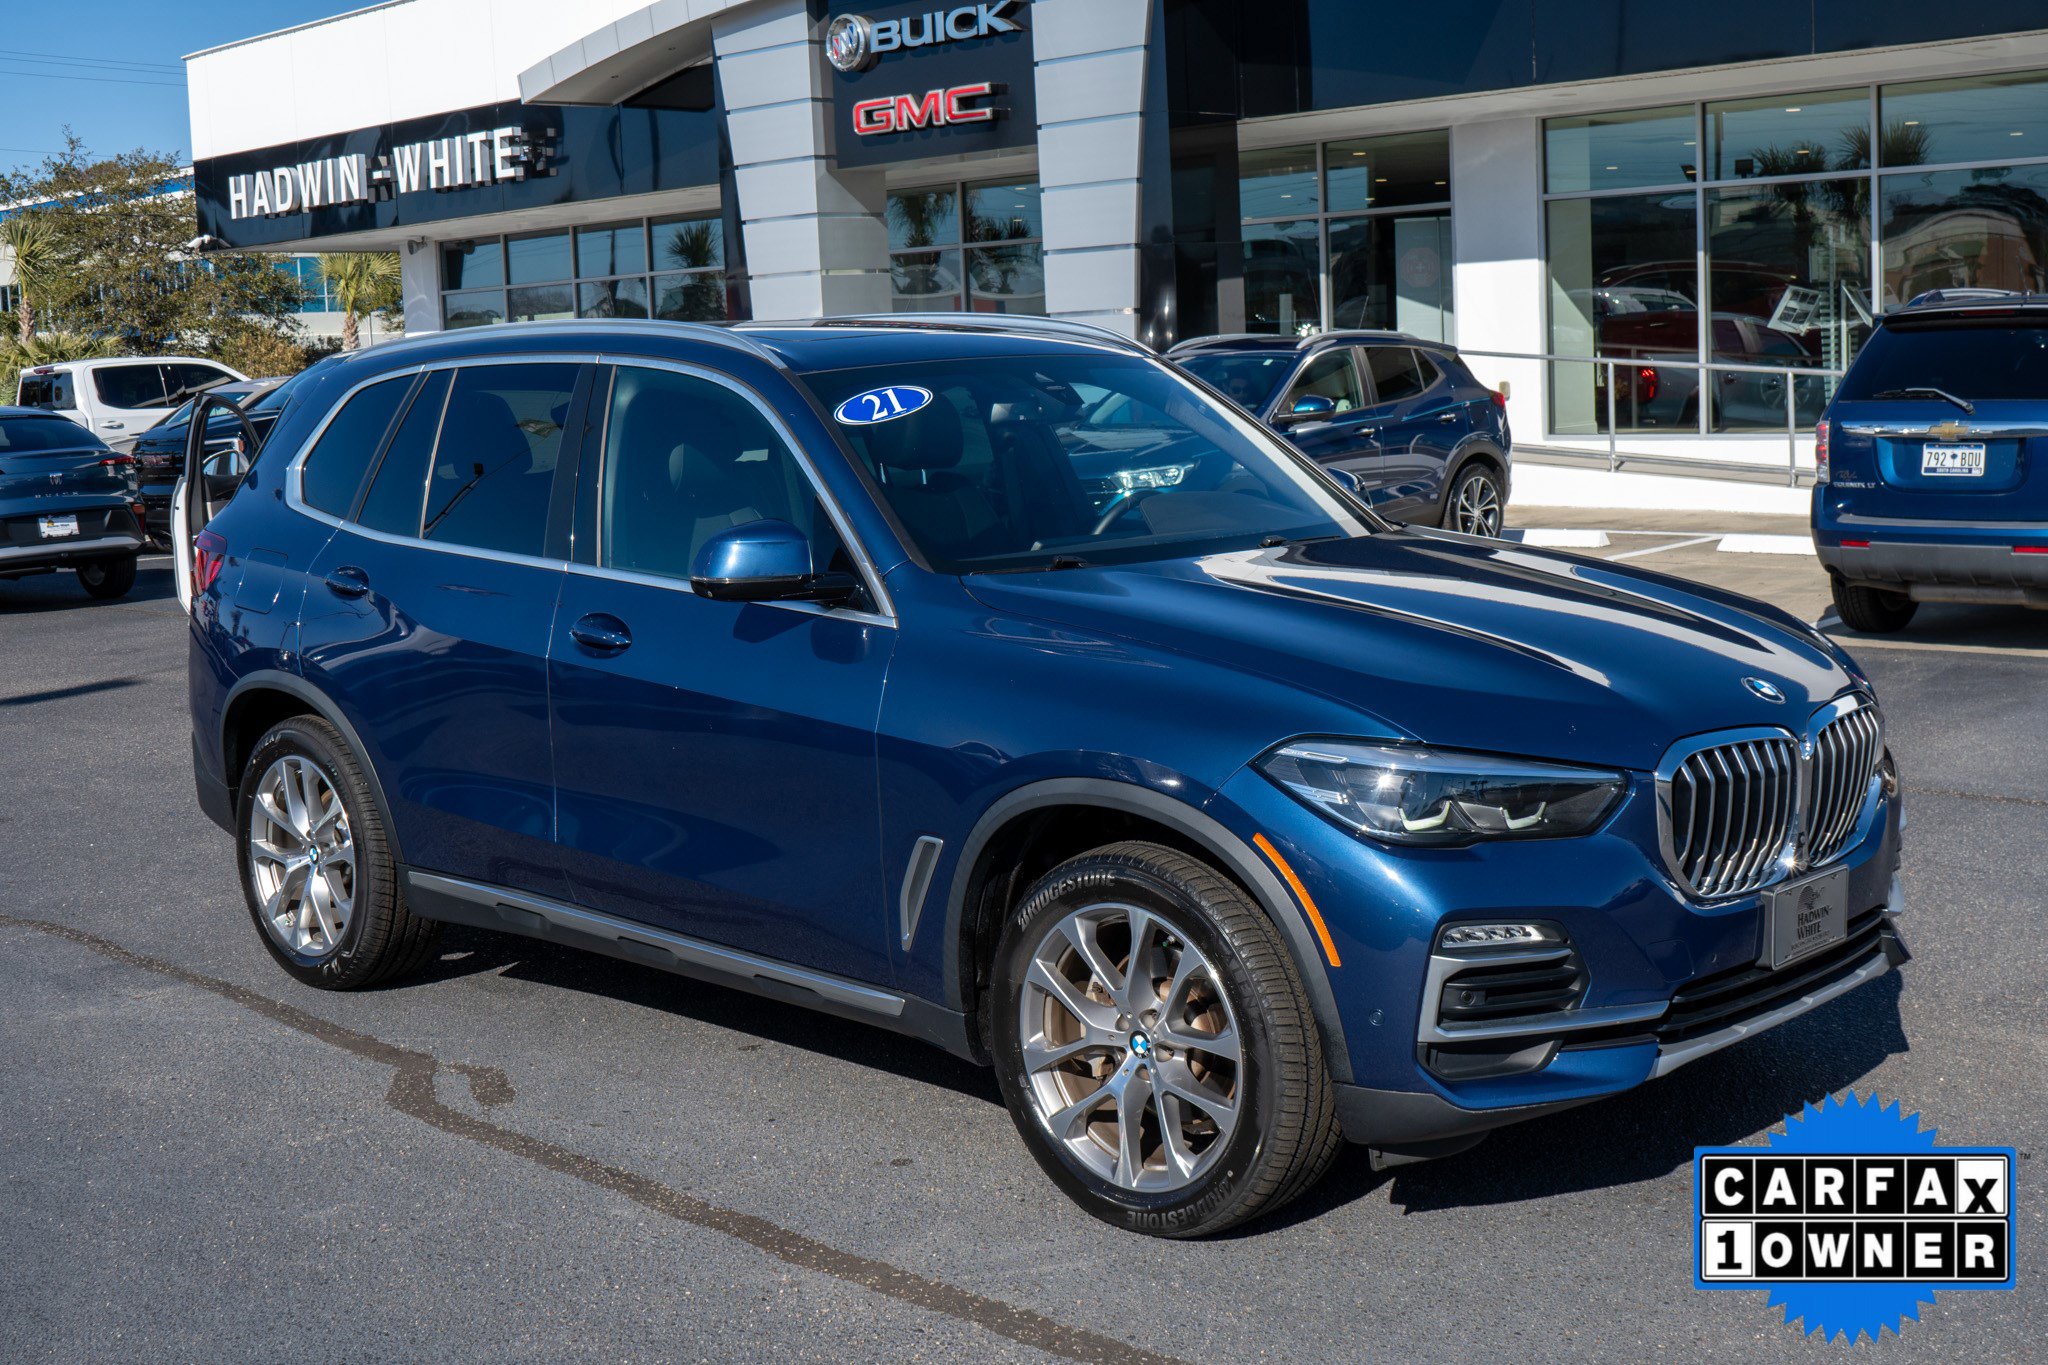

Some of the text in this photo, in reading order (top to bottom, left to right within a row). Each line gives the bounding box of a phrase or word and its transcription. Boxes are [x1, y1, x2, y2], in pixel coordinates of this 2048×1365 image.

[870, 0, 1014, 54] BUICK
[853, 81, 994, 136] GMC
[861, 388, 908, 421] 21
[1926, 451, 1947, 467] 792
[1797, 905, 1831, 928] HADWIN
[1797, 921, 1822, 940] WHITE
